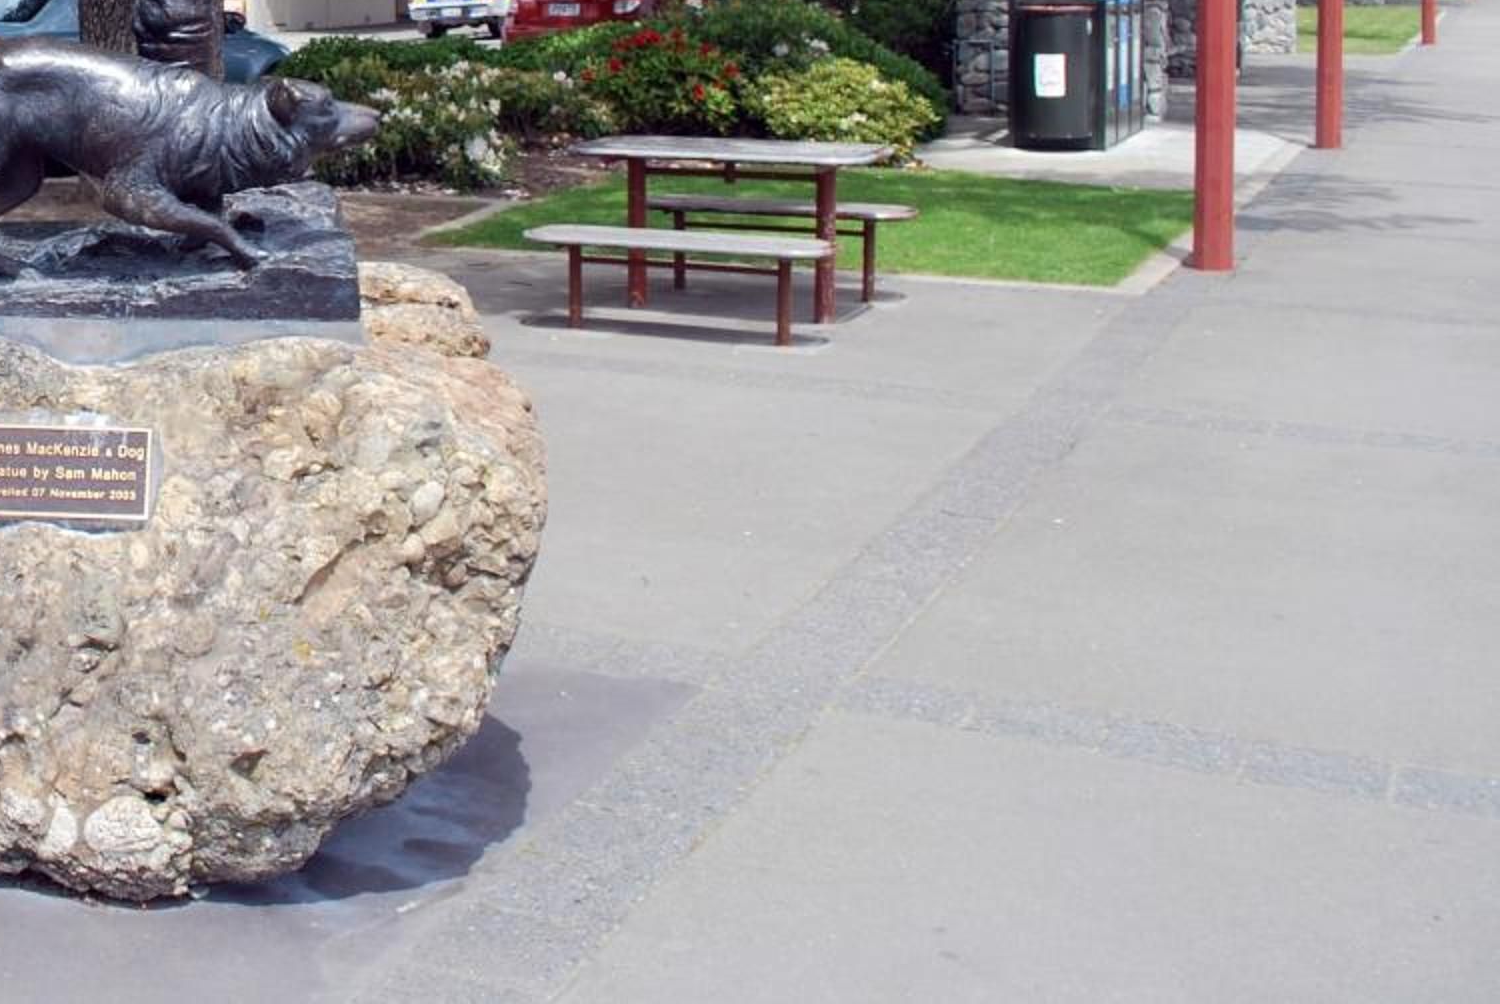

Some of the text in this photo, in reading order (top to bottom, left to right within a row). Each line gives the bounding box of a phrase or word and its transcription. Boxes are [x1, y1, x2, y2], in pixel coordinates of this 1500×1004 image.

[25, 441, 100, 457] MacKenzie
[117, 444, 145, 461] Dog
[33, 465, 49, 481] by
[55, 466, 85, 480] Sam
[91, 467, 136, 481] Mahon
[31, 487, 45, 498] 07
[50, 487, 105, 499] November
